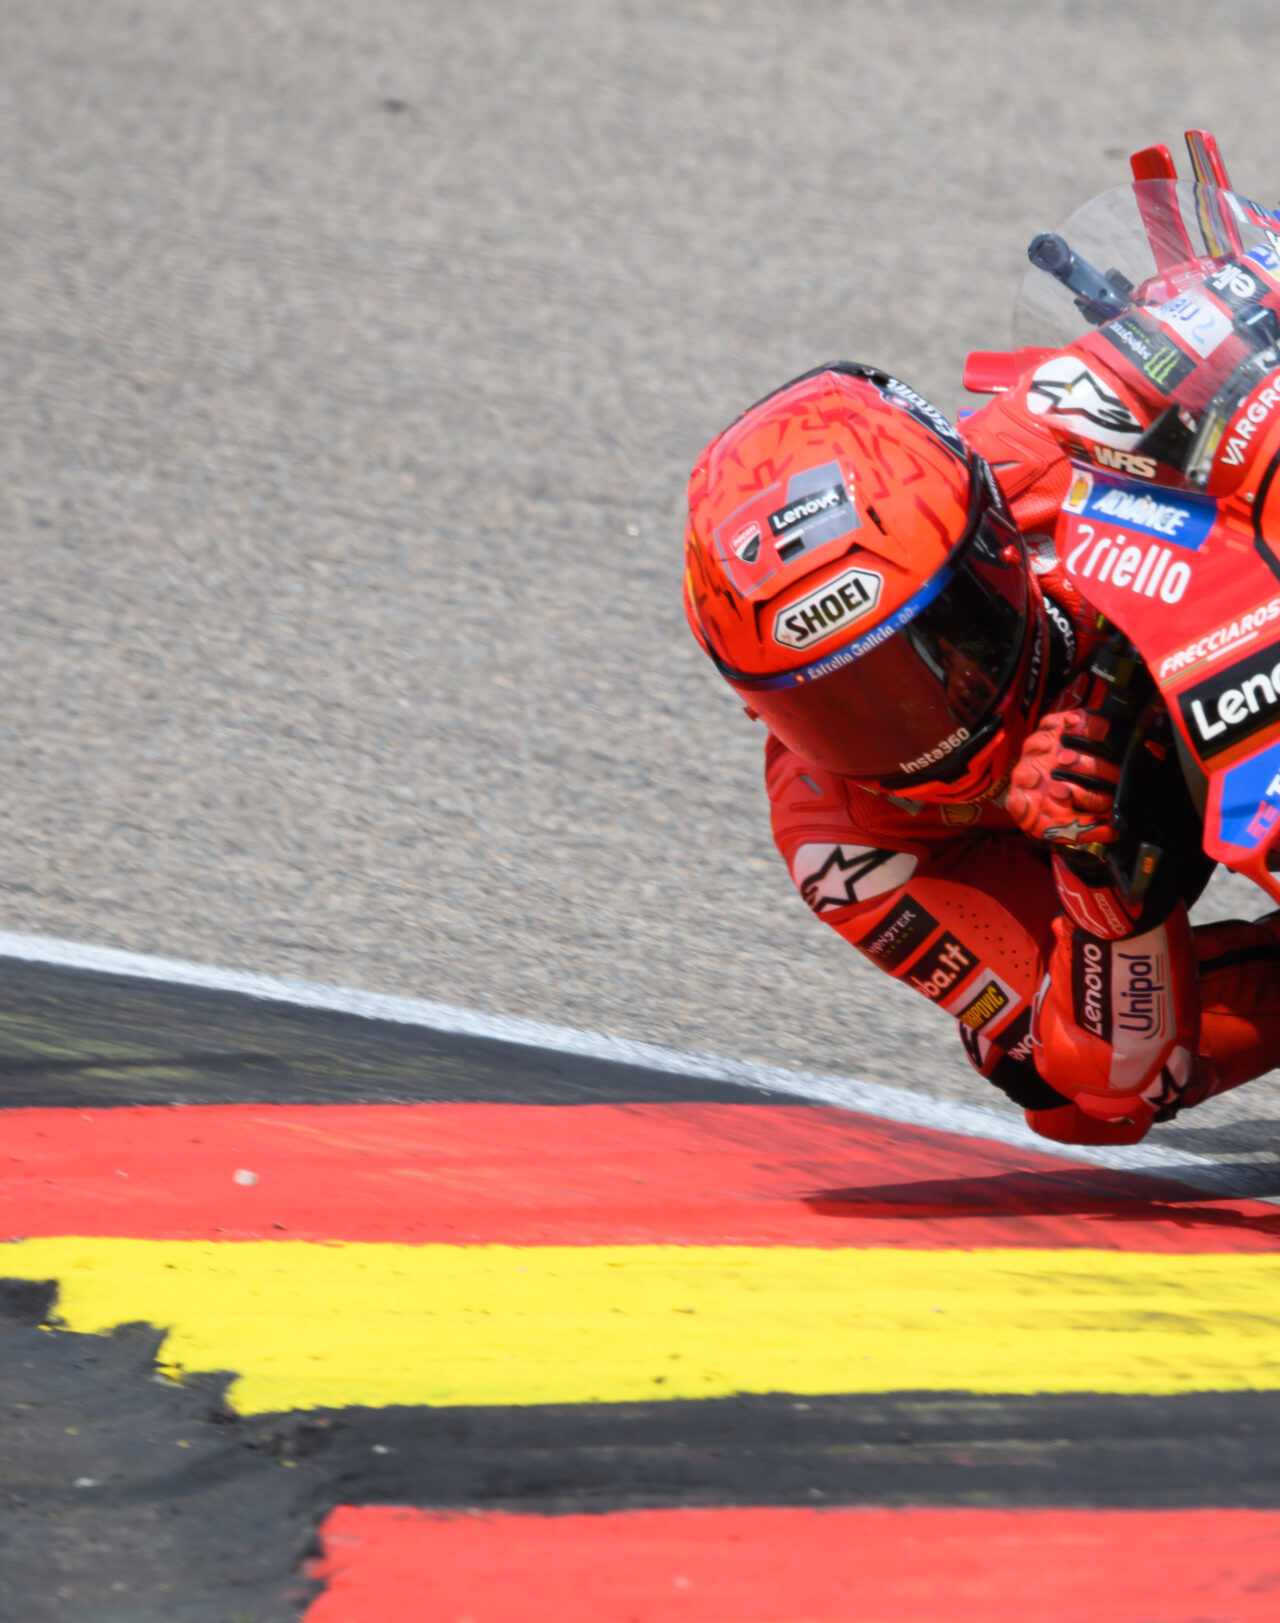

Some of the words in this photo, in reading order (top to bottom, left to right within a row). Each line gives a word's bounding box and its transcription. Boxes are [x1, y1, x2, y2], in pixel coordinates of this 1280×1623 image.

[1090, 489, 1191, 537] ADVANCE
[1083, 532, 1192, 604] riello
[785, 578, 870, 642] SHOEI
[899, 726, 971, 775] Insta360
[1083, 943, 1103, 1036] Lenovo
[1117, 953, 1165, 1031] Unipol
